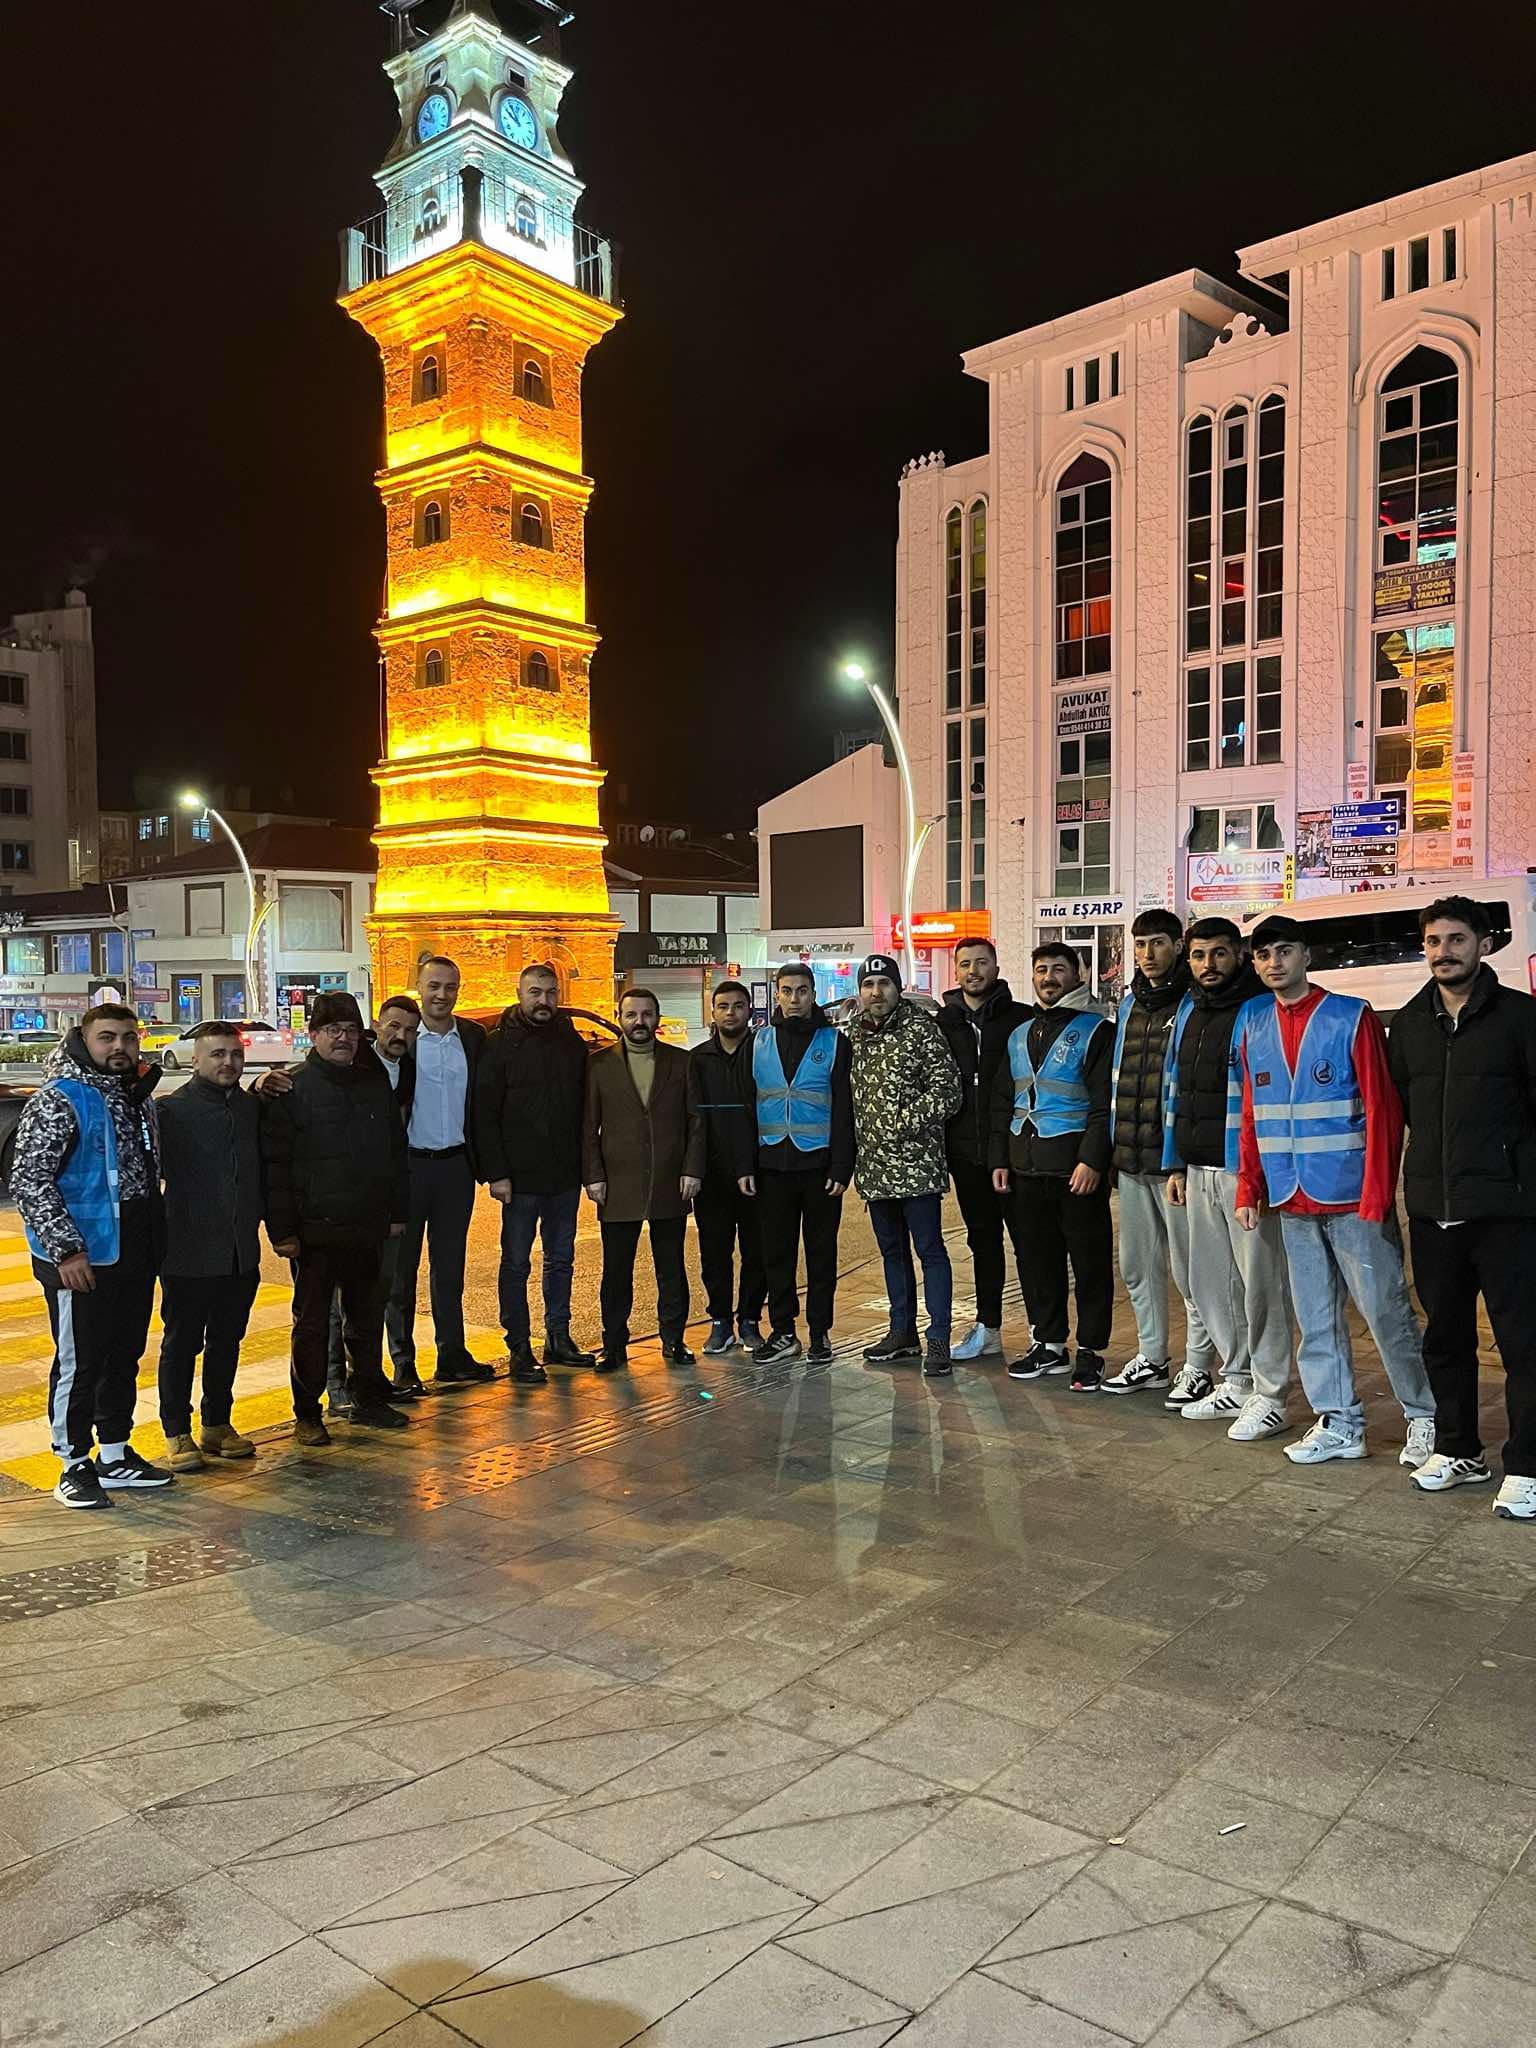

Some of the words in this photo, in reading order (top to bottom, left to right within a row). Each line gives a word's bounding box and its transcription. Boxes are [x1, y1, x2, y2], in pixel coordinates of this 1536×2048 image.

[1061, 691, 1108, 708] AVUKAT
[1059, 708, 1087, 722] Abdullah
[1088, 704, 1110, 718] AKYÜZ
[1216, 858, 1281, 875] ALDEMİR
[1040, 904, 1067, 917] mia
[1072, 901, 1123, 919] EŞARP
[656, 936, 709, 954] YAŞAR
